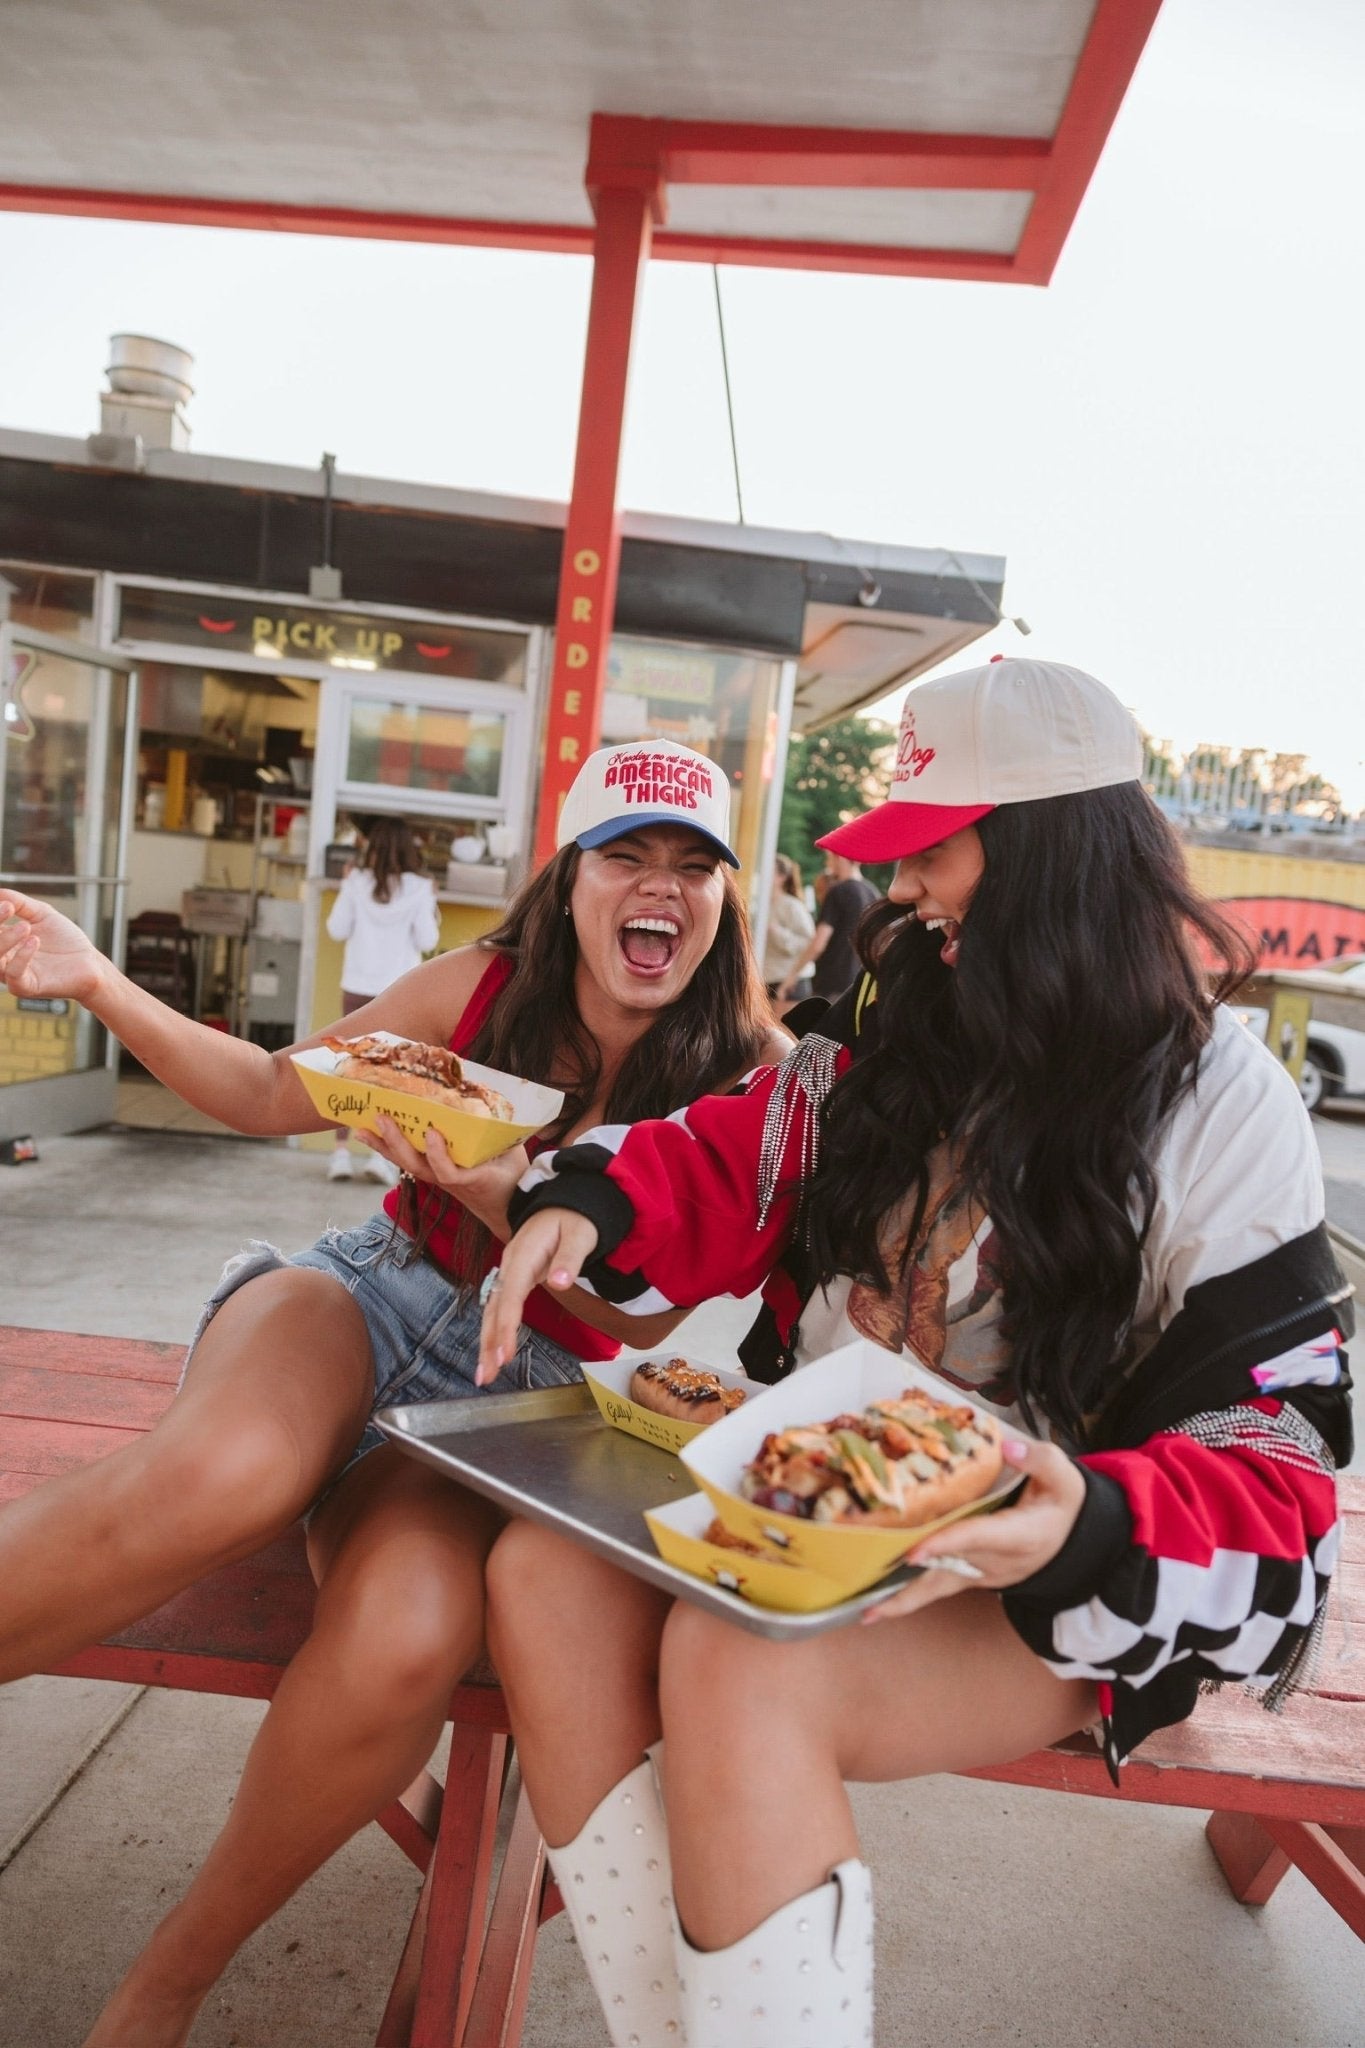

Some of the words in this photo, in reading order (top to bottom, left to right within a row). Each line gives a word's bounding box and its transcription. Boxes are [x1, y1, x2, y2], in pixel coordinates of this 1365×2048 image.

[253, 616, 337, 650] PICK
[356, 629, 403, 657] UP
[559, 549, 600, 762] ORDER
[604, 762, 712, 798] AMERICAN
[623, 782, 698, 809] THIGHS
[1259, 927, 1365, 961] MAT
[327, 1091, 371, 1117] Golly!
